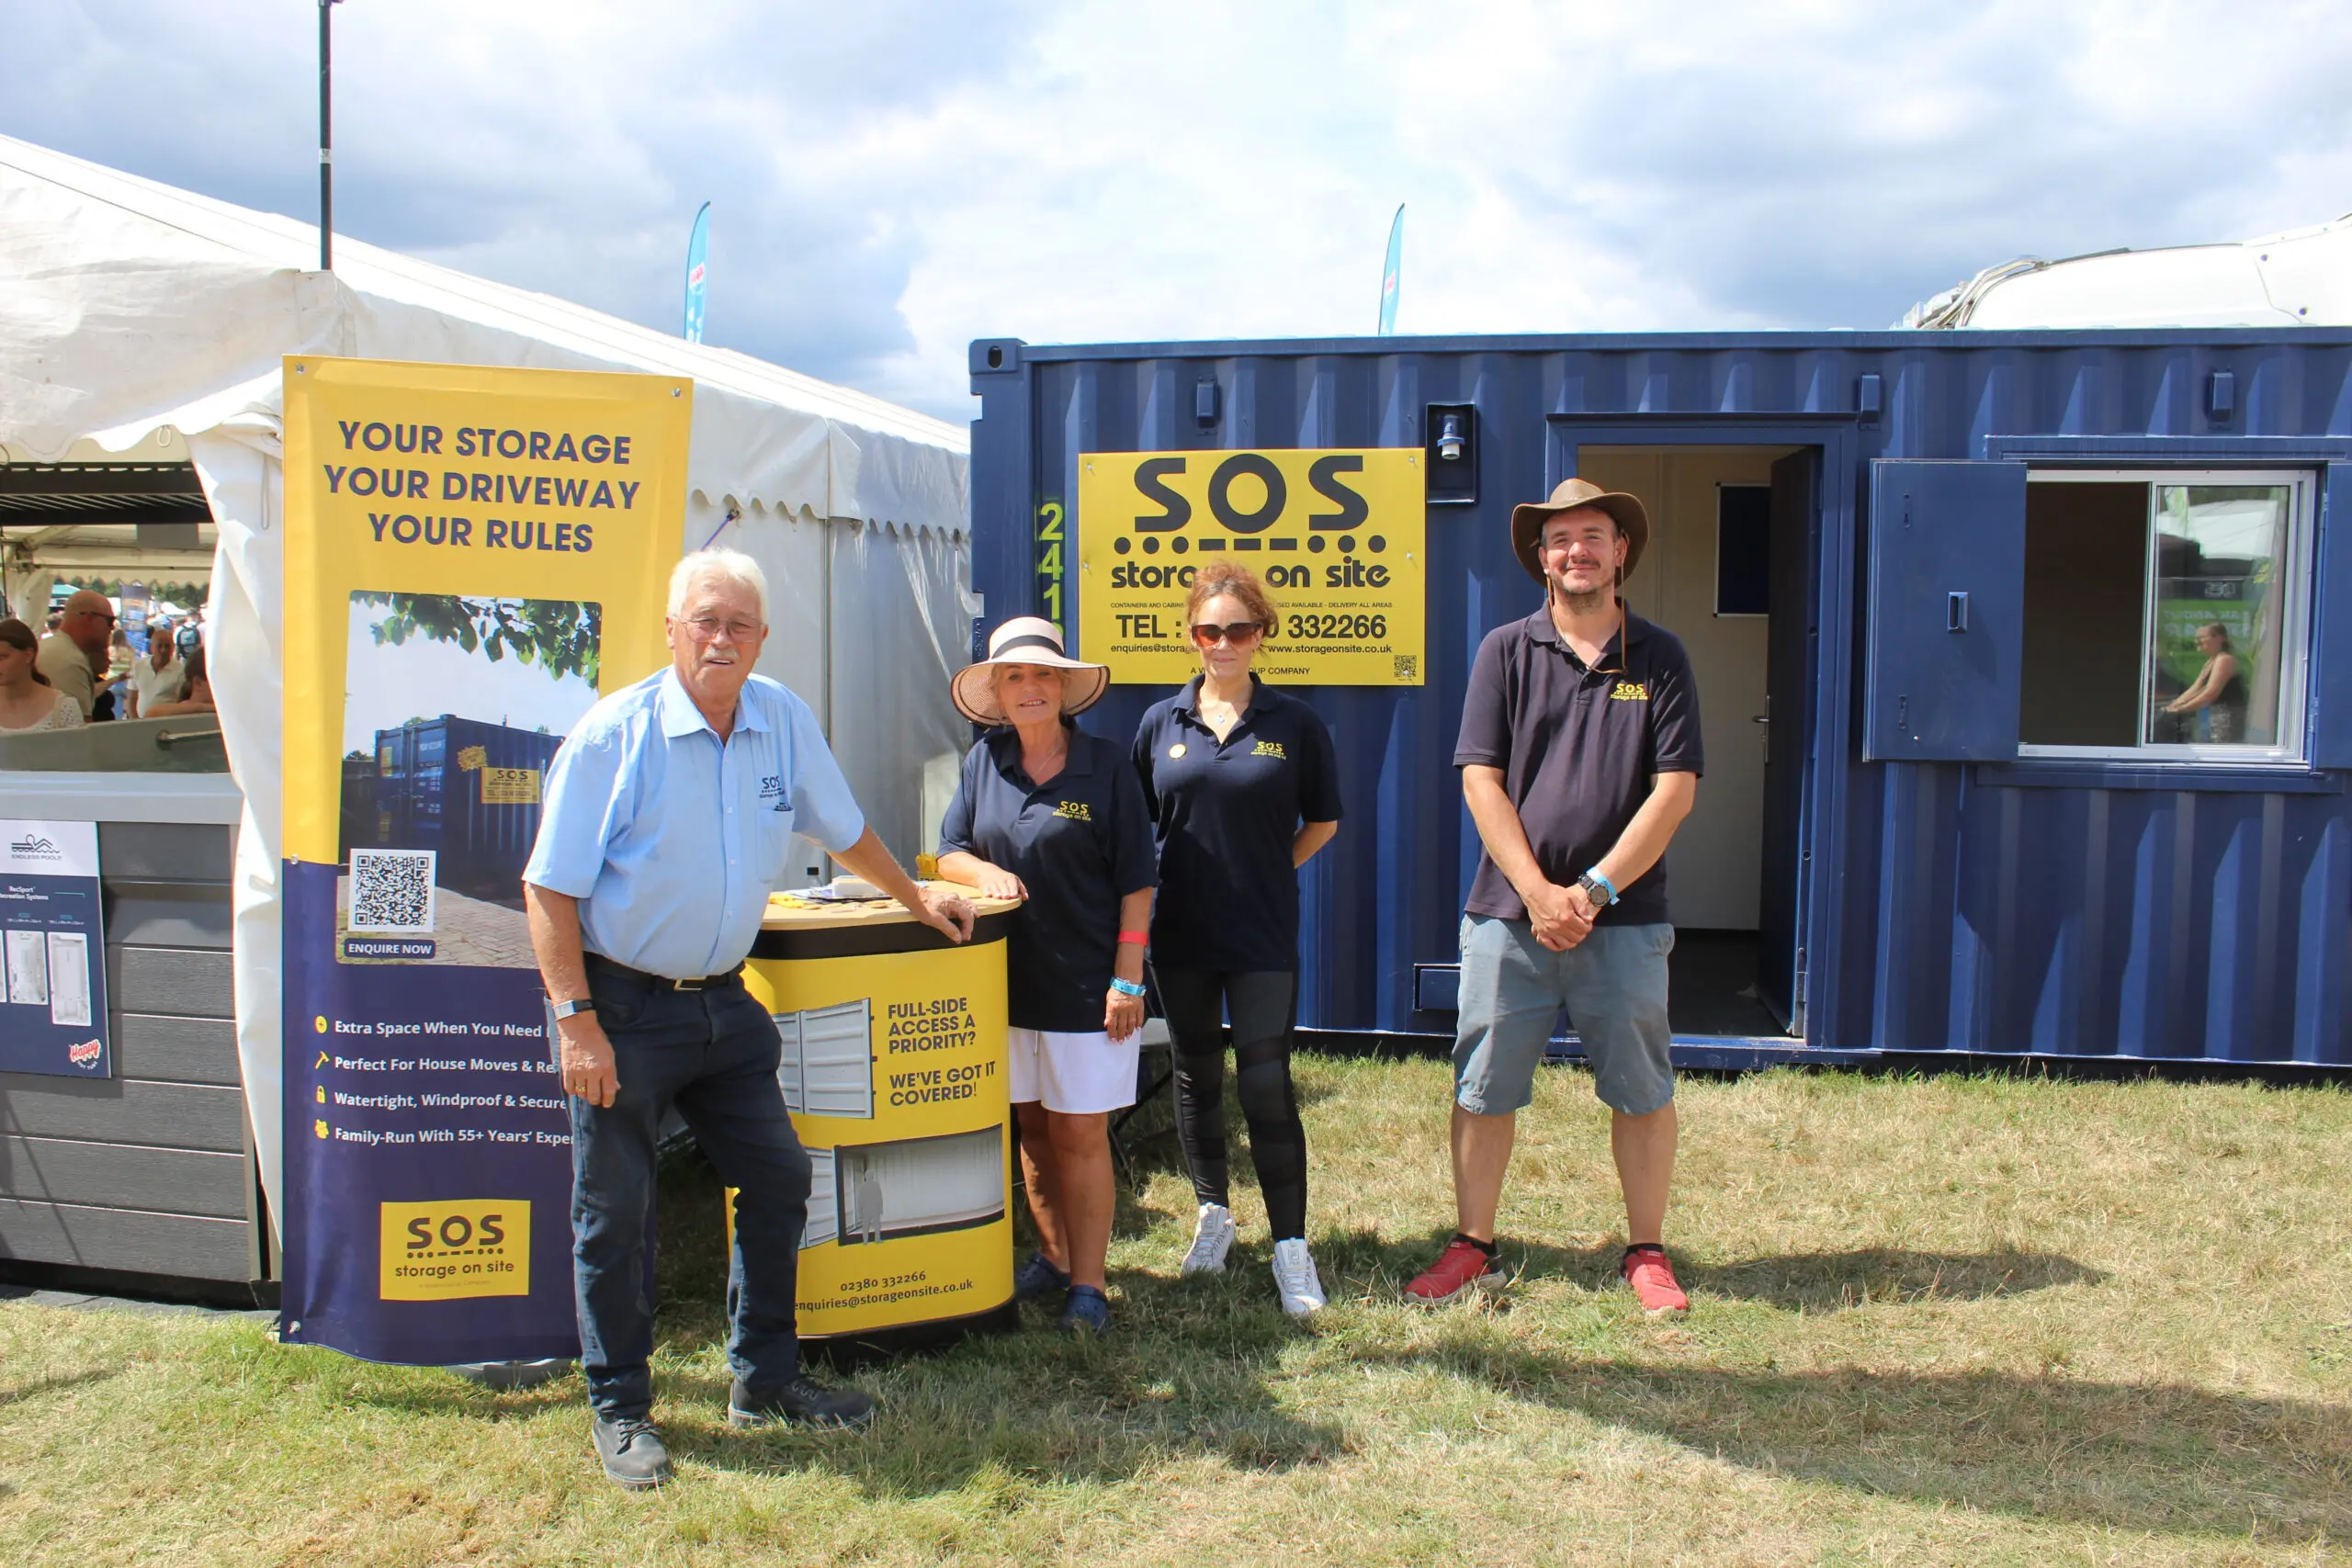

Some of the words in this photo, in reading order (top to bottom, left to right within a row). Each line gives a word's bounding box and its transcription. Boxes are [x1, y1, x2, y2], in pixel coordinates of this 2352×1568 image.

[338, 421, 444, 455] YOUR
[456, 427, 632, 465] STORAGE
[323, 464, 429, 499] YOUR
[443, 472, 640, 510] DRIVEWAY
[1134, 453, 1369, 534] SOS
[368, 513, 472, 547] YOUR
[486, 519, 594, 553] RULES
[1265, 565, 1310, 588] on
[1326, 556, 1392, 588] site
[1115, 615, 1167, 638] TEL
[1287, 614, 1386, 638] 332266
[1268, 644, 1392, 655] www.storageonsite.co.uk
[1268, 667, 1310, 675] COMPANY
[1616, 682, 1644, 694] SOS
[1257, 741, 1283, 752] SOS
[497, 770, 528, 780] SOS
[762, 775, 780, 790] SOS
[1059, 800, 1089, 814] SOS
[348, 942, 401, 955] ENQUIRE
[401, 943, 432, 954] NOW
[888, 997, 967, 1020] FULL-SIDE
[334, 1021, 372, 1034] Extra
[376, 1021, 421, 1038] Space
[424, 1021, 468, 1034] When
[471, 1022, 500, 1035] You
[504, 1024, 542, 1037] Need
[888, 1015, 959, 1037] ACCESS
[964, 1013, 976, 1029] A
[70, 1039, 101, 1063] Happy
[888, 1031, 977, 1055] PRIORITY?
[334, 1056, 387, 1071] Perfect
[390, 1058, 415, 1071] For
[419, 1058, 466, 1071] House
[470, 1059, 518, 1072] Moves
[521, 1060, 533, 1073] &
[889, 1070, 942, 1089] WE'VE
[946, 1064, 982, 1083] GOT
[986, 1060, 996, 1077] IT
[334, 1091, 417, 1111] Watertight,
[421, 1094, 503, 1109] Windproof
[504, 1095, 516, 1107] &
[889, 1081, 978, 1107] COVERED!
[334, 1127, 414, 1145] Family-Run
[419, 1129, 454, 1143] With
[458, 1129, 484, 1141] 55+
[406, 1214, 505, 1250] SOS
[395, 1264, 458, 1280] storage
[462, 1263, 481, 1274] on
[487, 1260, 515, 1273] site
[840, 1278, 878, 1292] 02380
[882, 1270, 927, 1289] 332266
[794, 1279, 974, 1314] enquiries@storageonsite.co.uk
